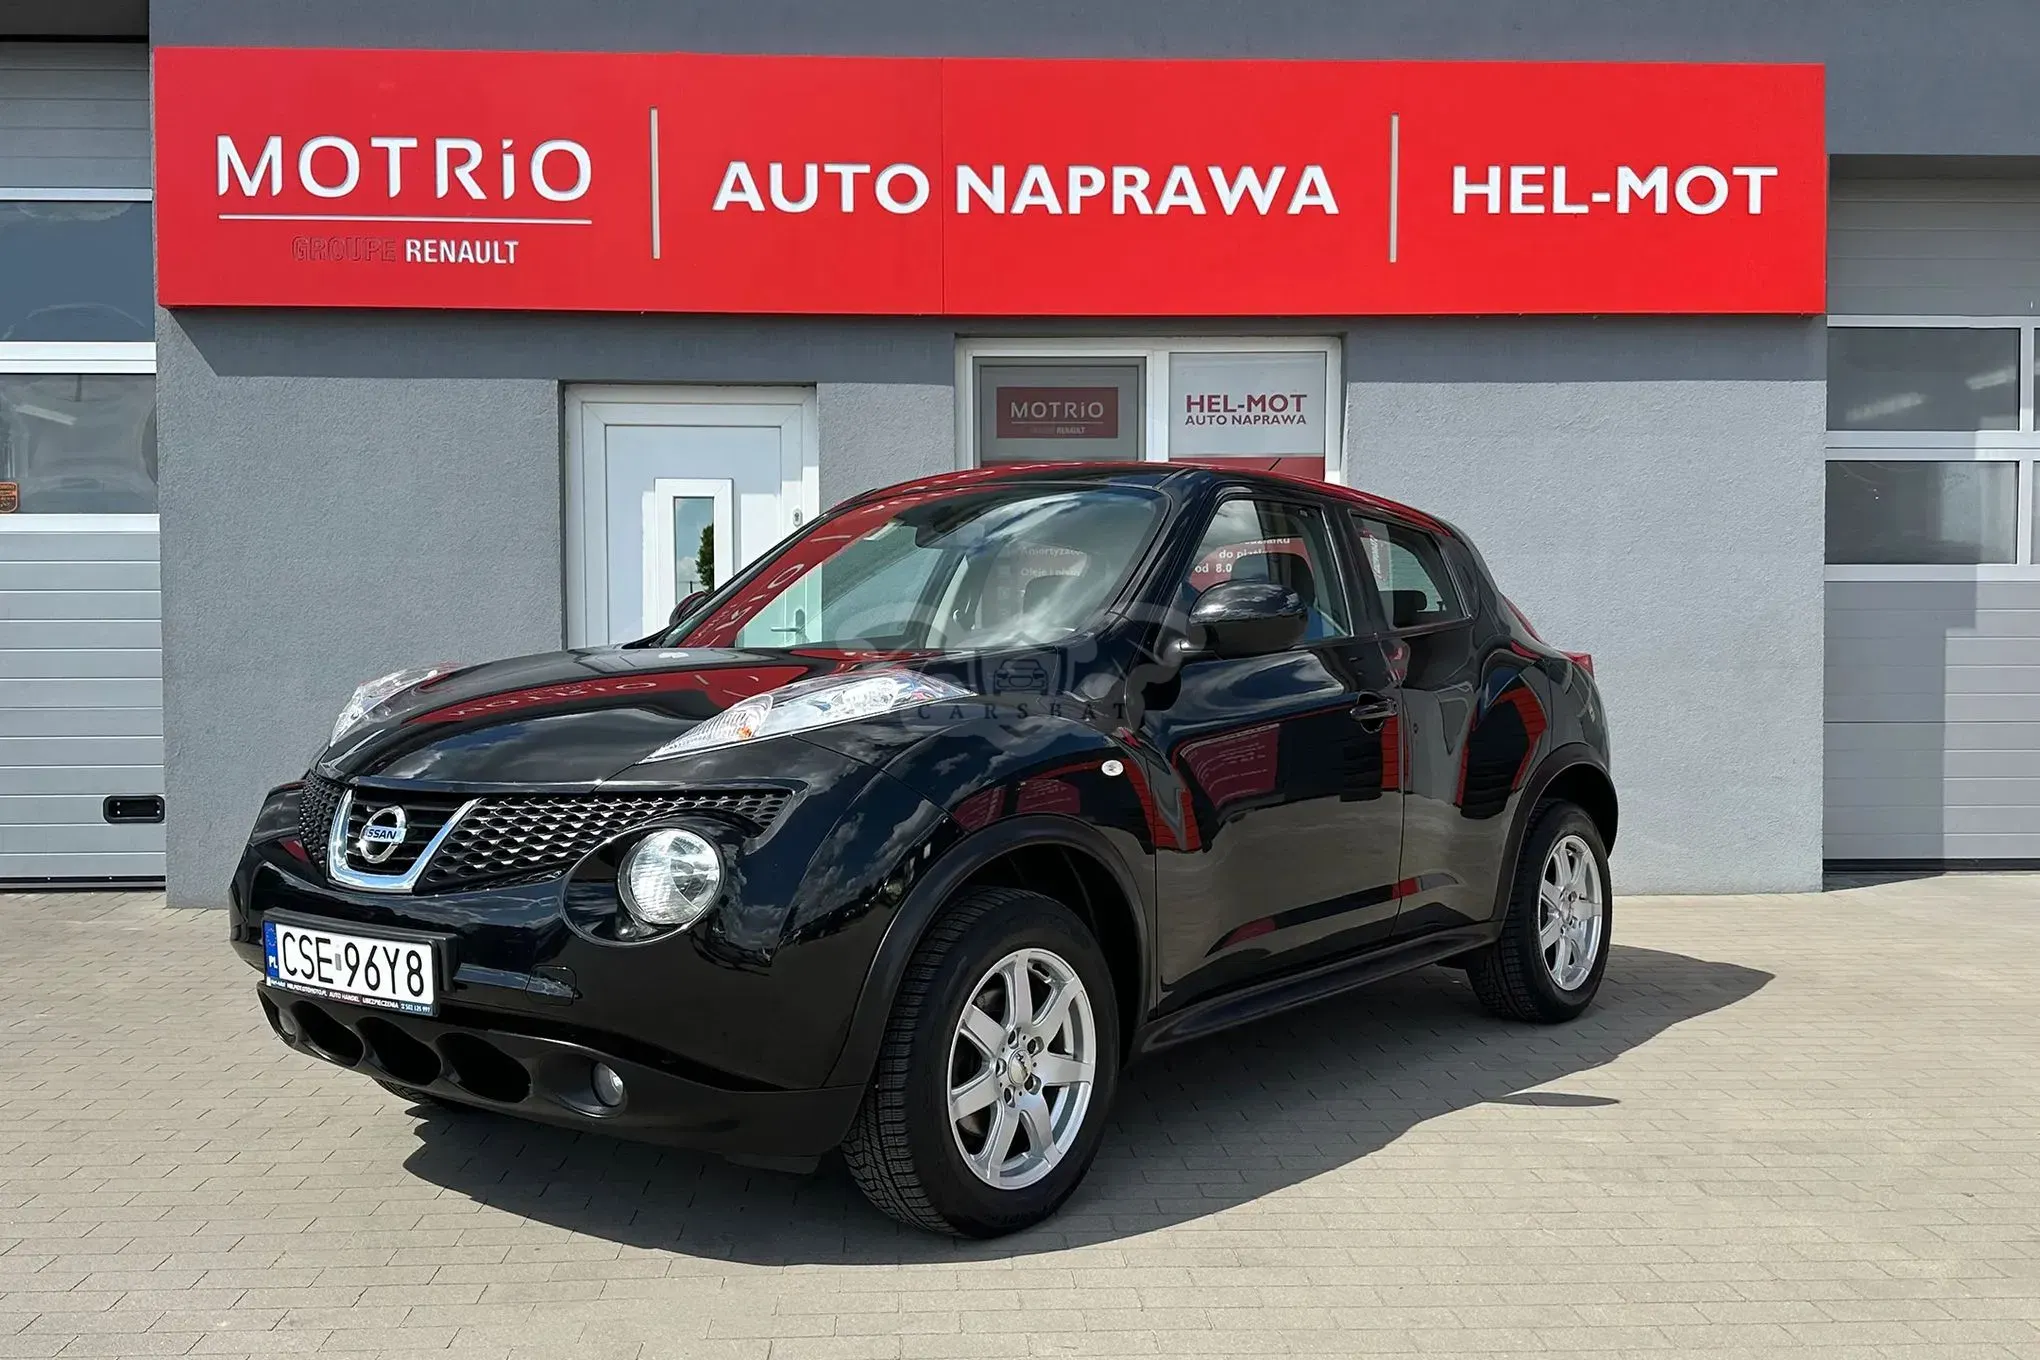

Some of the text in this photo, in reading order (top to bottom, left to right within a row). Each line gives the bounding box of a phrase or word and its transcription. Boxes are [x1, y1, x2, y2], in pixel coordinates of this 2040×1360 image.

[711, 160, 1340, 215] AUTO NAPRAWA
[1452, 165, 1778, 215] HEL-MOT
[291, 235, 519, 265] GROUPE RENAULT
[1186, 394, 1307, 413] HEL-MOT
[1185, 414, 1307, 426] AUTO NAPRAWA
[1218, 549, 1234, 559] do
[1194, 563, 1233, 573] od 8.0
[269, 955, 278, 969] PL
[282, 931, 425, 997] CSE 96Y8
